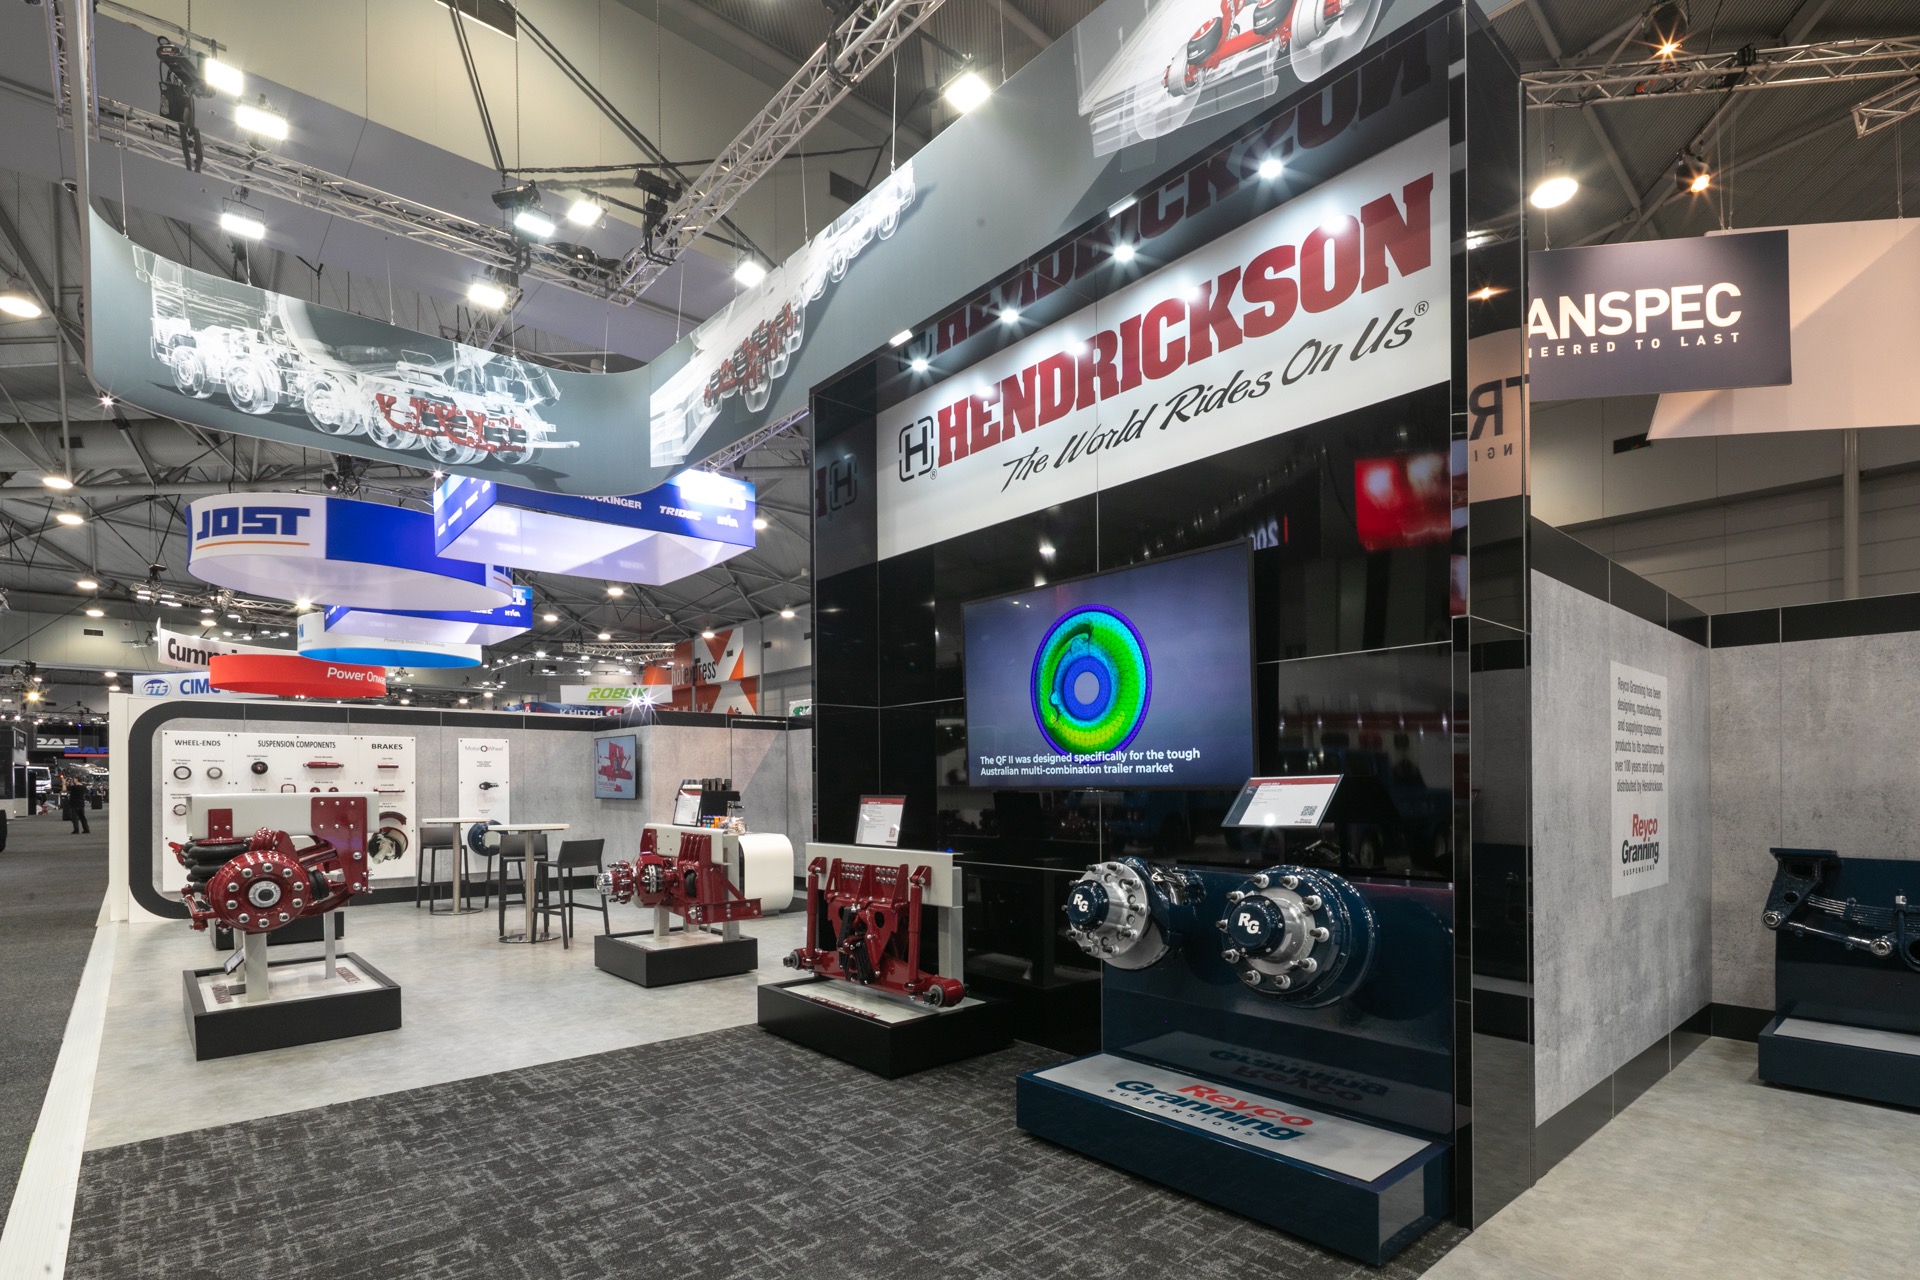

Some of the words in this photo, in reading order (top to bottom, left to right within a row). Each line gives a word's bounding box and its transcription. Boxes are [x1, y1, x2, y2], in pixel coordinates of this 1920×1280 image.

[937, 173, 1434, 468] HENDRICKSON
[1636, 338, 1661, 351] TO
[1680, 332, 1740, 347] LAST
[1002, 446, 1048, 493] The
[1054, 406, 1152, 469] World
[1165, 369, 1271, 430] Rides
[1282, 338, 1336, 387] On
[197, 507, 311, 540] JOST
[327, 667, 365, 681] Power
[588, 687, 648, 699] ROBUK
[37, 738, 78, 746] DAF
[174, 739, 221, 747] WHEEL-ENDS
[257, 740, 294, 748] SUSPENSION
[296, 740, 336, 749] COMPONENTS
[371, 743, 403, 751] BRAKES
[980, 756, 994, 765] The
[995, 755, 1007, 766] QF
[1015, 756, 1031, 764] was
[1033, 752, 1072, 765] designed
[1074, 750, 1127, 763] specifically
[1129, 750, 1144, 760] for
[1146, 749, 1164, 760] the
[1167, 748, 1200, 761] tough
[980, 766, 1019, 776] Australian
[1021, 764, 1102, 775] multi-combination
[1104, 763, 1134, 774] trailer
[1135, 762, 1174, 773] market
[1632, 813, 1658, 842] Reyco
[1622, 837, 1659, 864] Granning
[1107, 1088, 1254, 1137] SUSPENSIONS
[1115, 1080, 1305, 1141] Granning
[1177, 1085, 1313, 1127] Reyco
